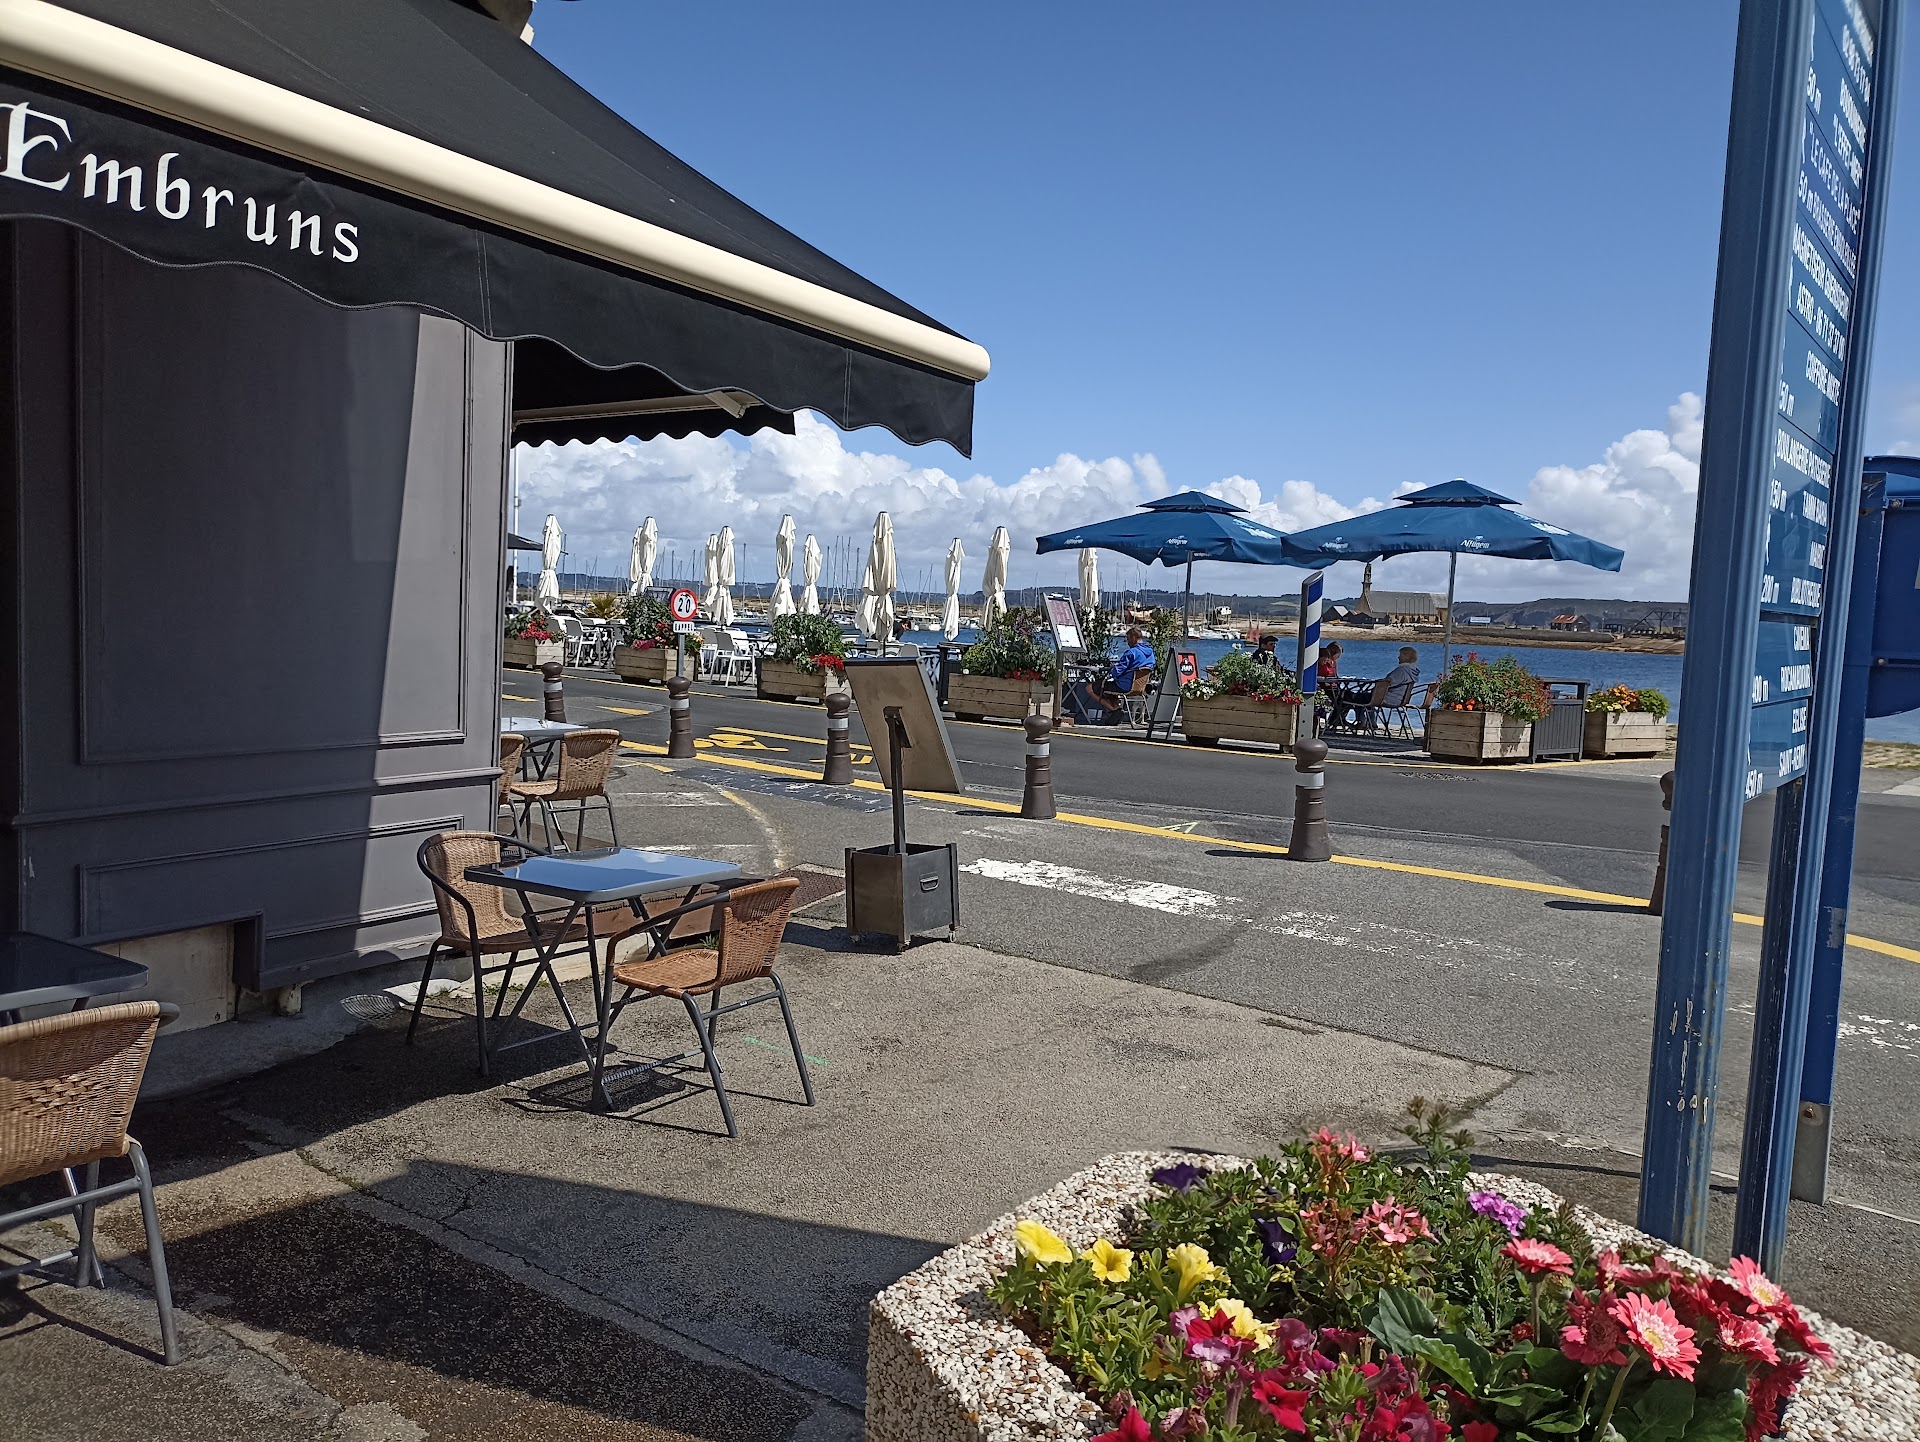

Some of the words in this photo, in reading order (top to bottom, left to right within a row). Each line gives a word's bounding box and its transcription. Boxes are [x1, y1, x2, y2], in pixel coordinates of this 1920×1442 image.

[0, 101, 359, 263] Embruns
[1760, 573, 1774, 603] 200
[677, 597, 691, 614] 20
[1762, 680, 1769, 701] m
[1756, 772, 1763, 794] m
